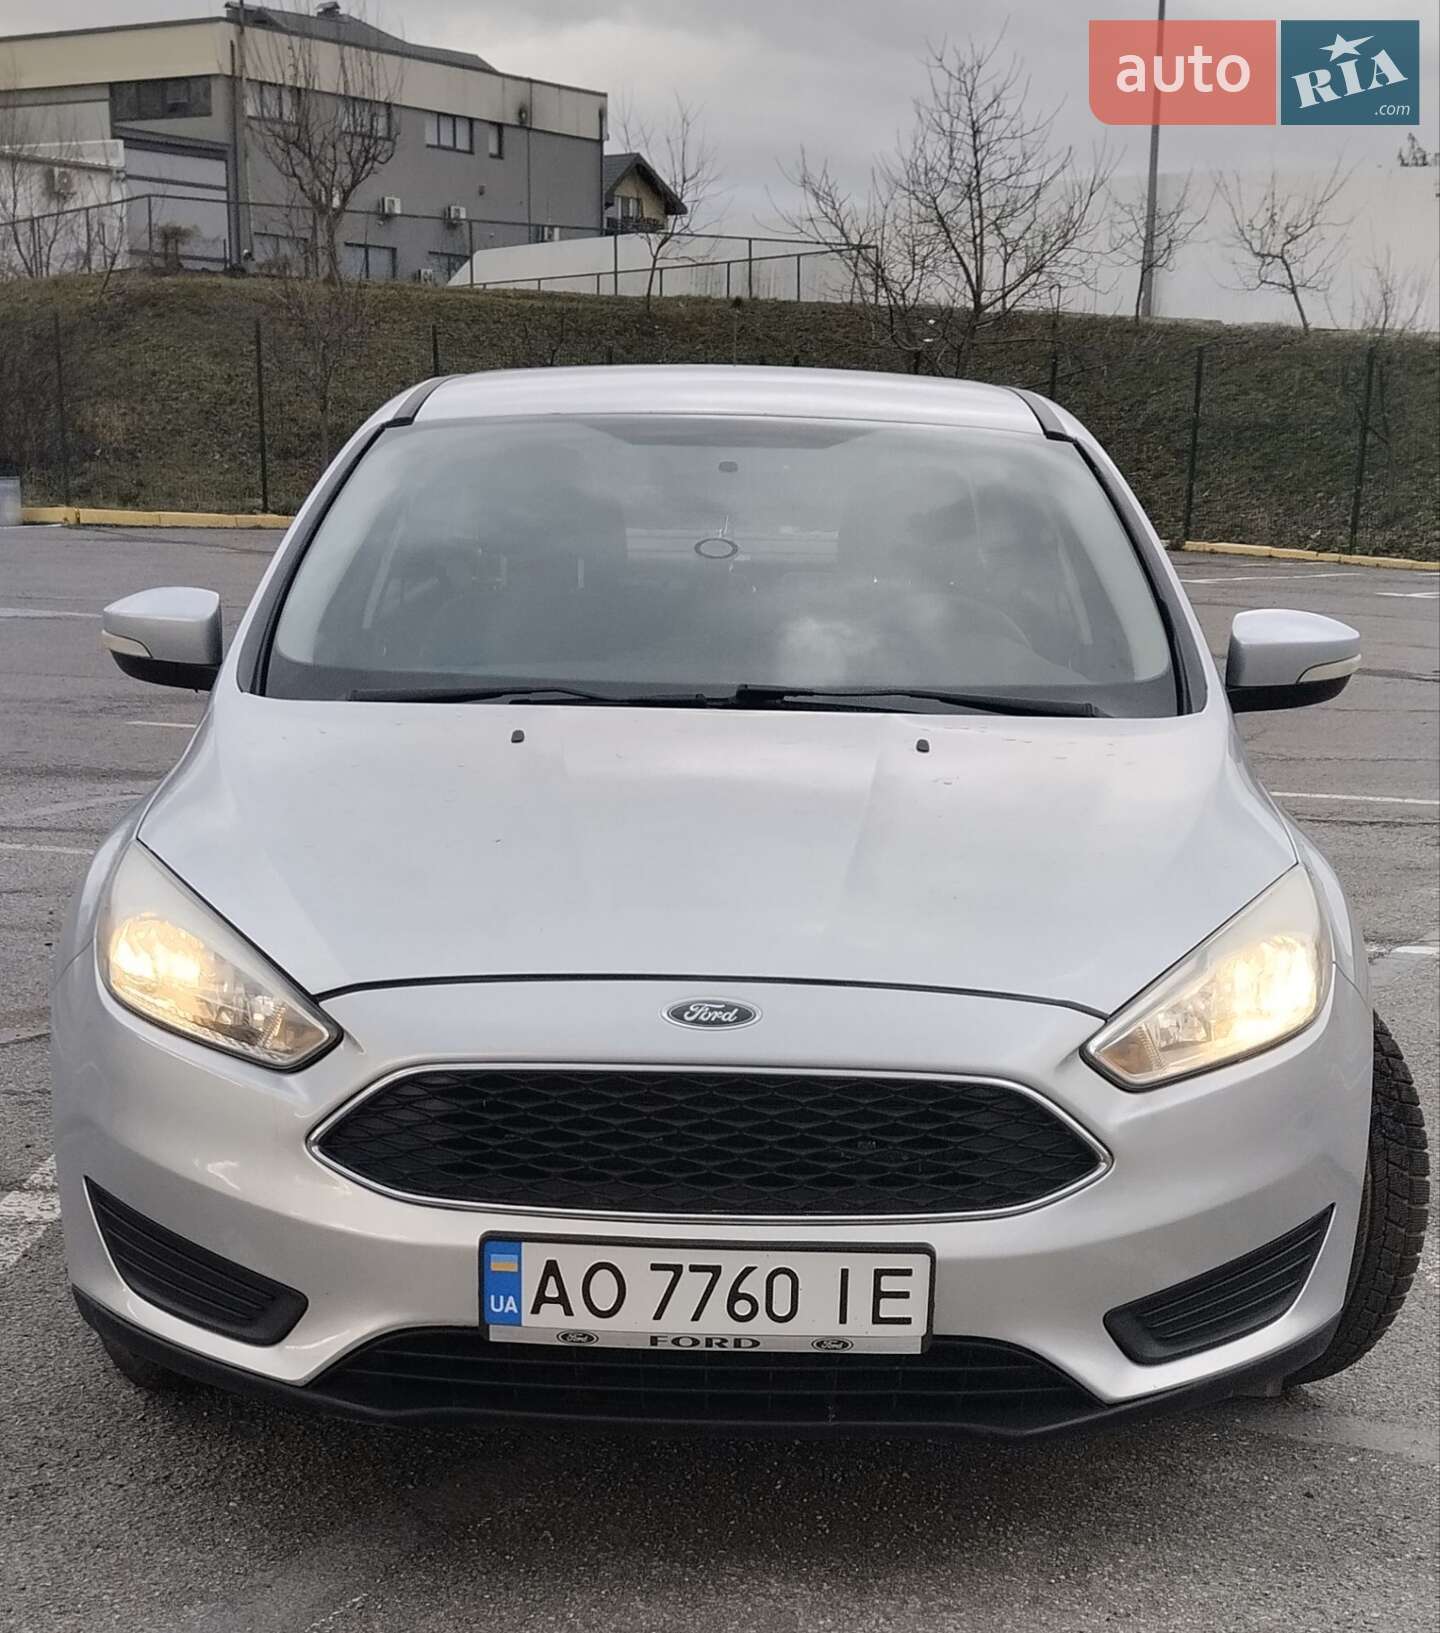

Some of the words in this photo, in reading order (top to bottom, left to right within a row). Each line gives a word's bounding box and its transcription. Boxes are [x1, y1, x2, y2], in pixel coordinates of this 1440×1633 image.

[683, 1002, 738, 1022] Ford
[530, 1259, 627, 1319] AO
[649, 1263, 799, 1324] 7760
[838, 1267, 913, 1325] IE
[490, 1295, 518, 1314] UA
[649, 1335, 761, 1350] FORD
